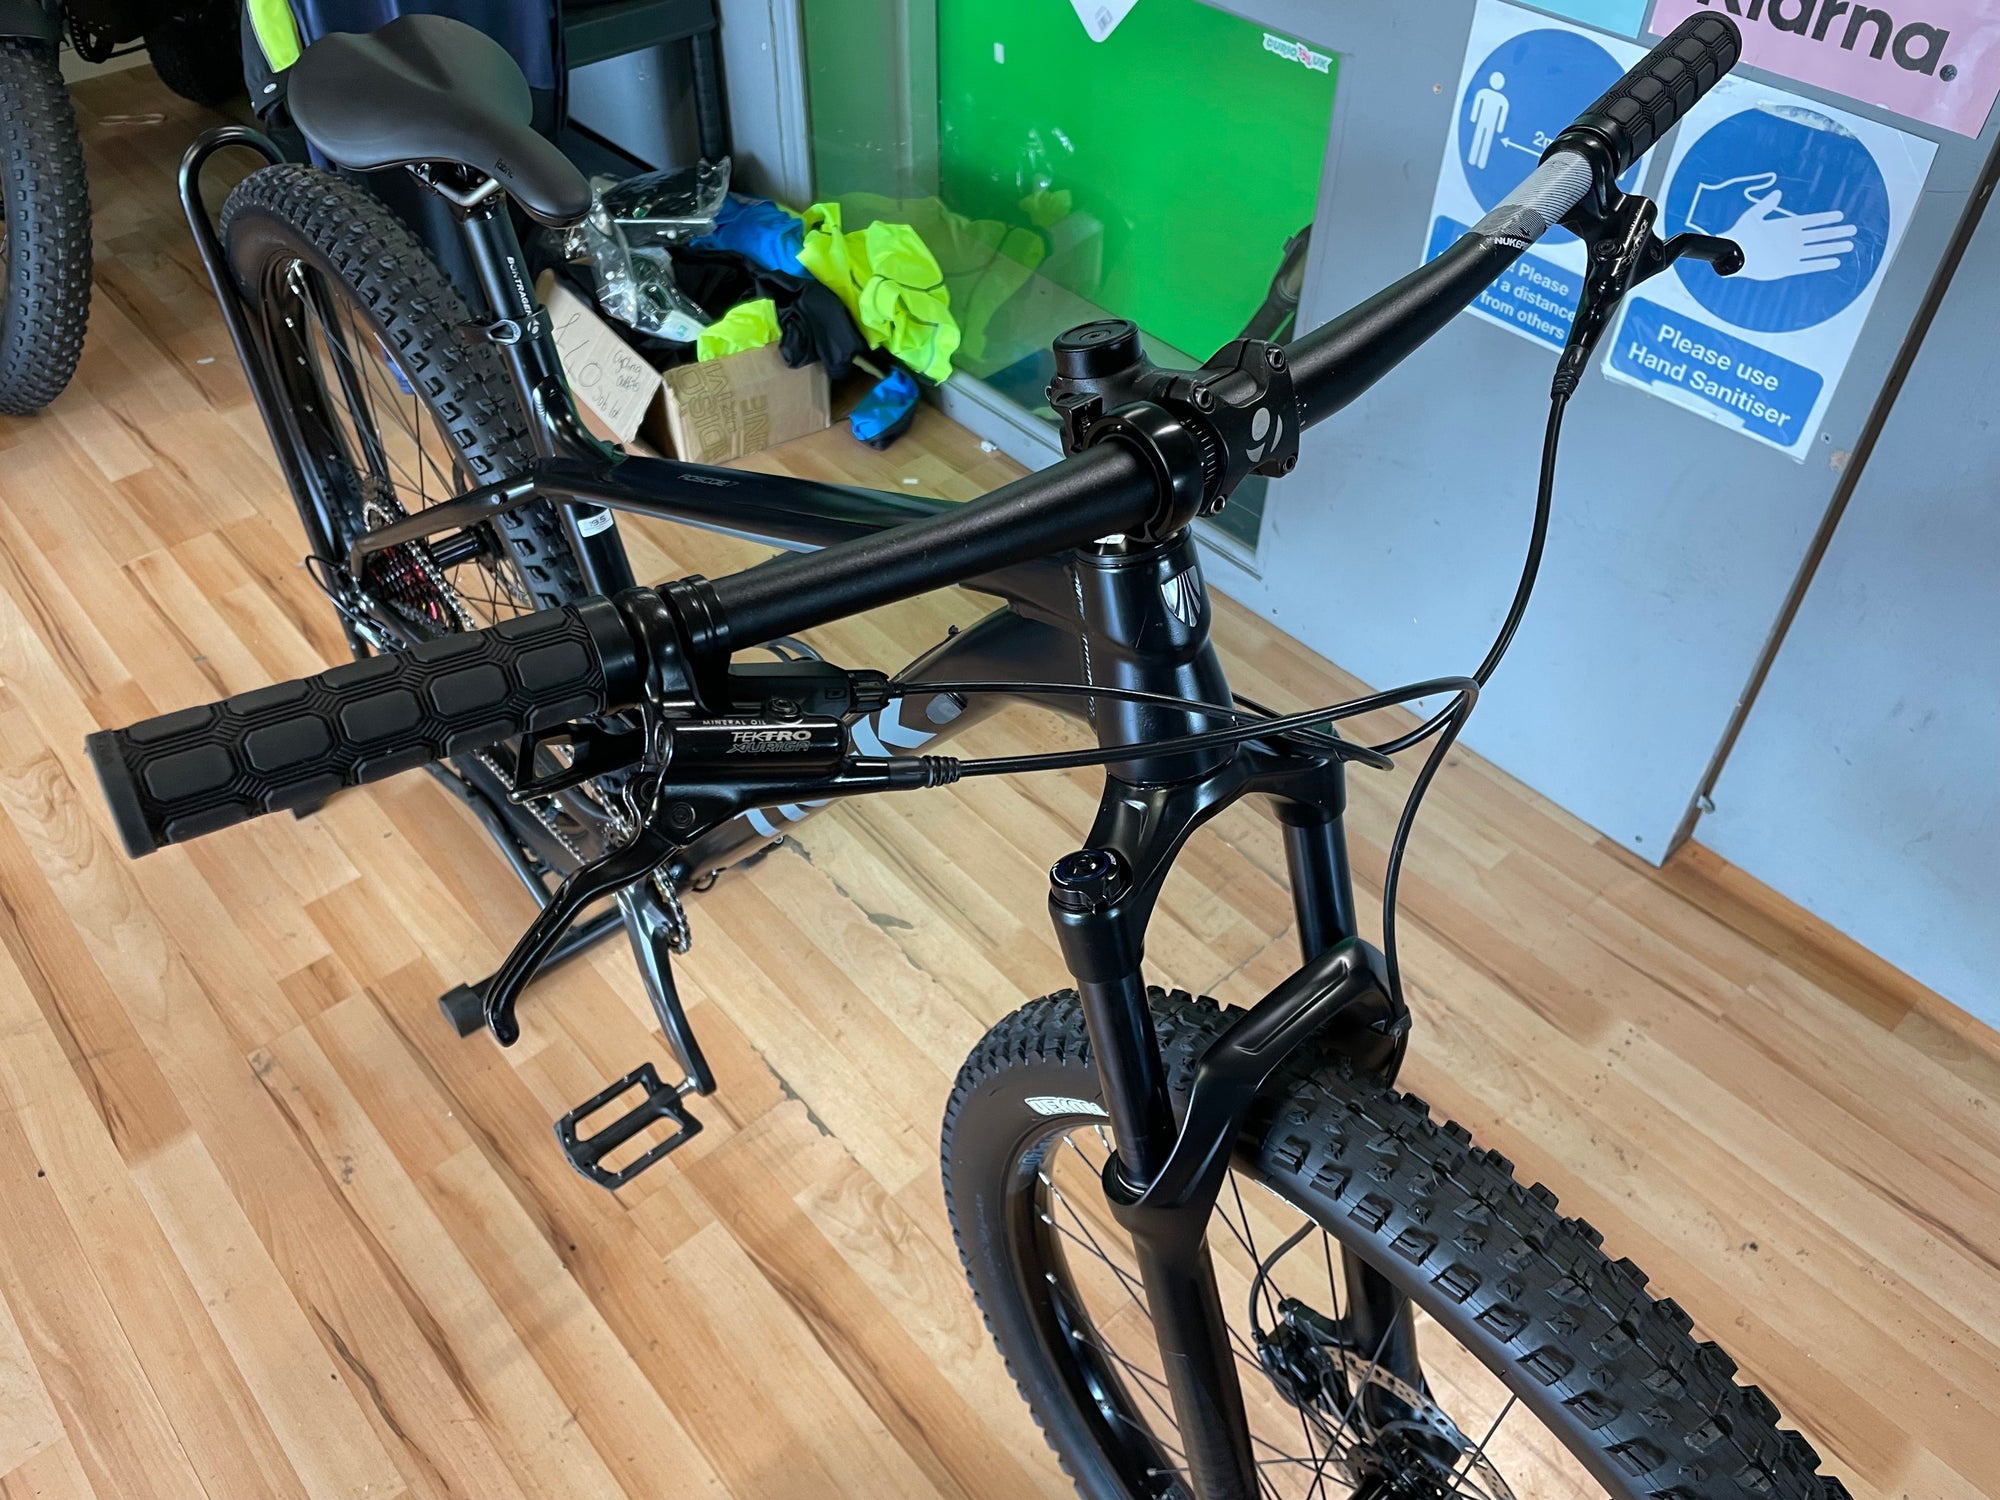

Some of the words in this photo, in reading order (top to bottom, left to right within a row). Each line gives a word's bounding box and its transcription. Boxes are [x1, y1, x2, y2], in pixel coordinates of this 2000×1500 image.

[1697, 0, 1957, 82] arna.
[1512, 285, 1577, 322] distance
[1518, 262, 1569, 297] Please
[1480, 290, 1515, 317] from
[1516, 312, 1566, 340] others
[1657, 324, 1732, 371] Please
[1736, 363, 1779, 391] use
[1628, 342, 1687, 381] Hand
[1688, 370, 1791, 427] Sanitiser
[730, 730, 812, 743] TEKTRO
